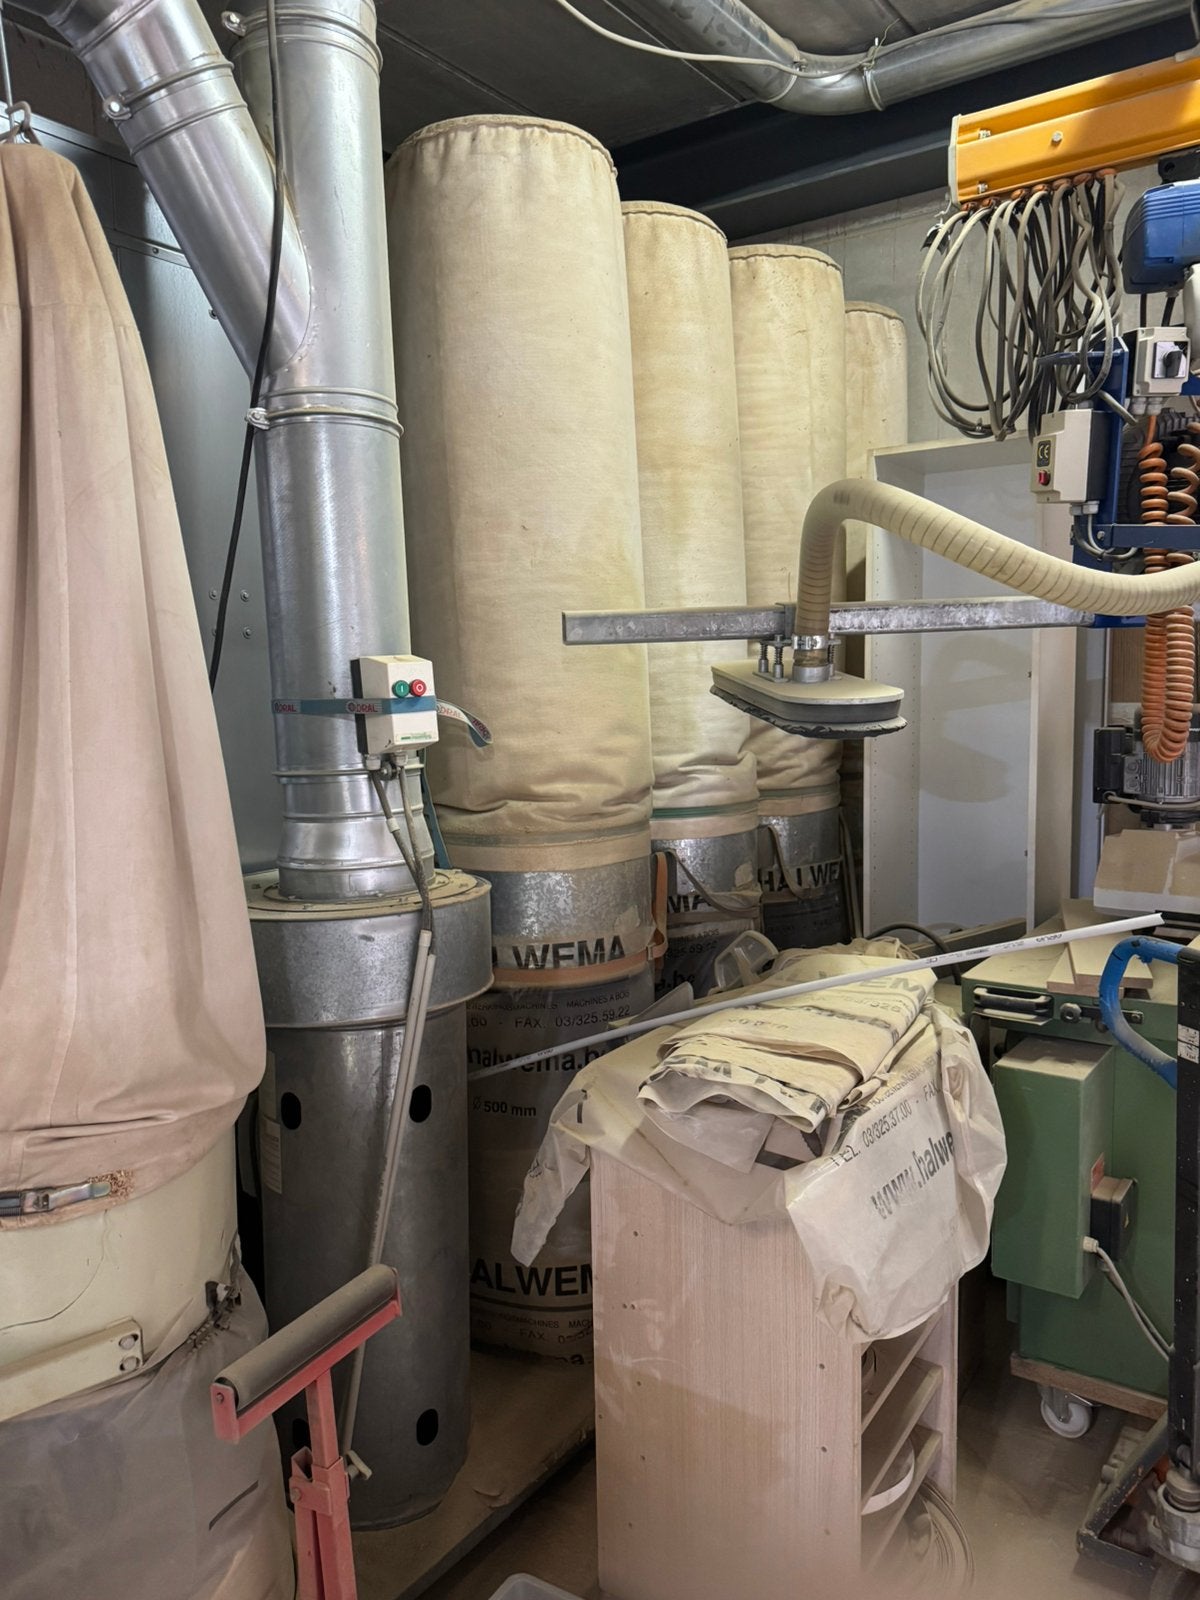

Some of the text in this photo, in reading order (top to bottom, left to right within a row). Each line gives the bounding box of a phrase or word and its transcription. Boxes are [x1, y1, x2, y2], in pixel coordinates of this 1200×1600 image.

[514, 1017, 546, 1029] FAX.
[555, 1004, 631, 1028] 03/325.59.22
[484, 1101, 508, 1114] 500
[511, 1105, 537, 1117] mm
[861, 1099, 913, 1148] 03/325.37.00
